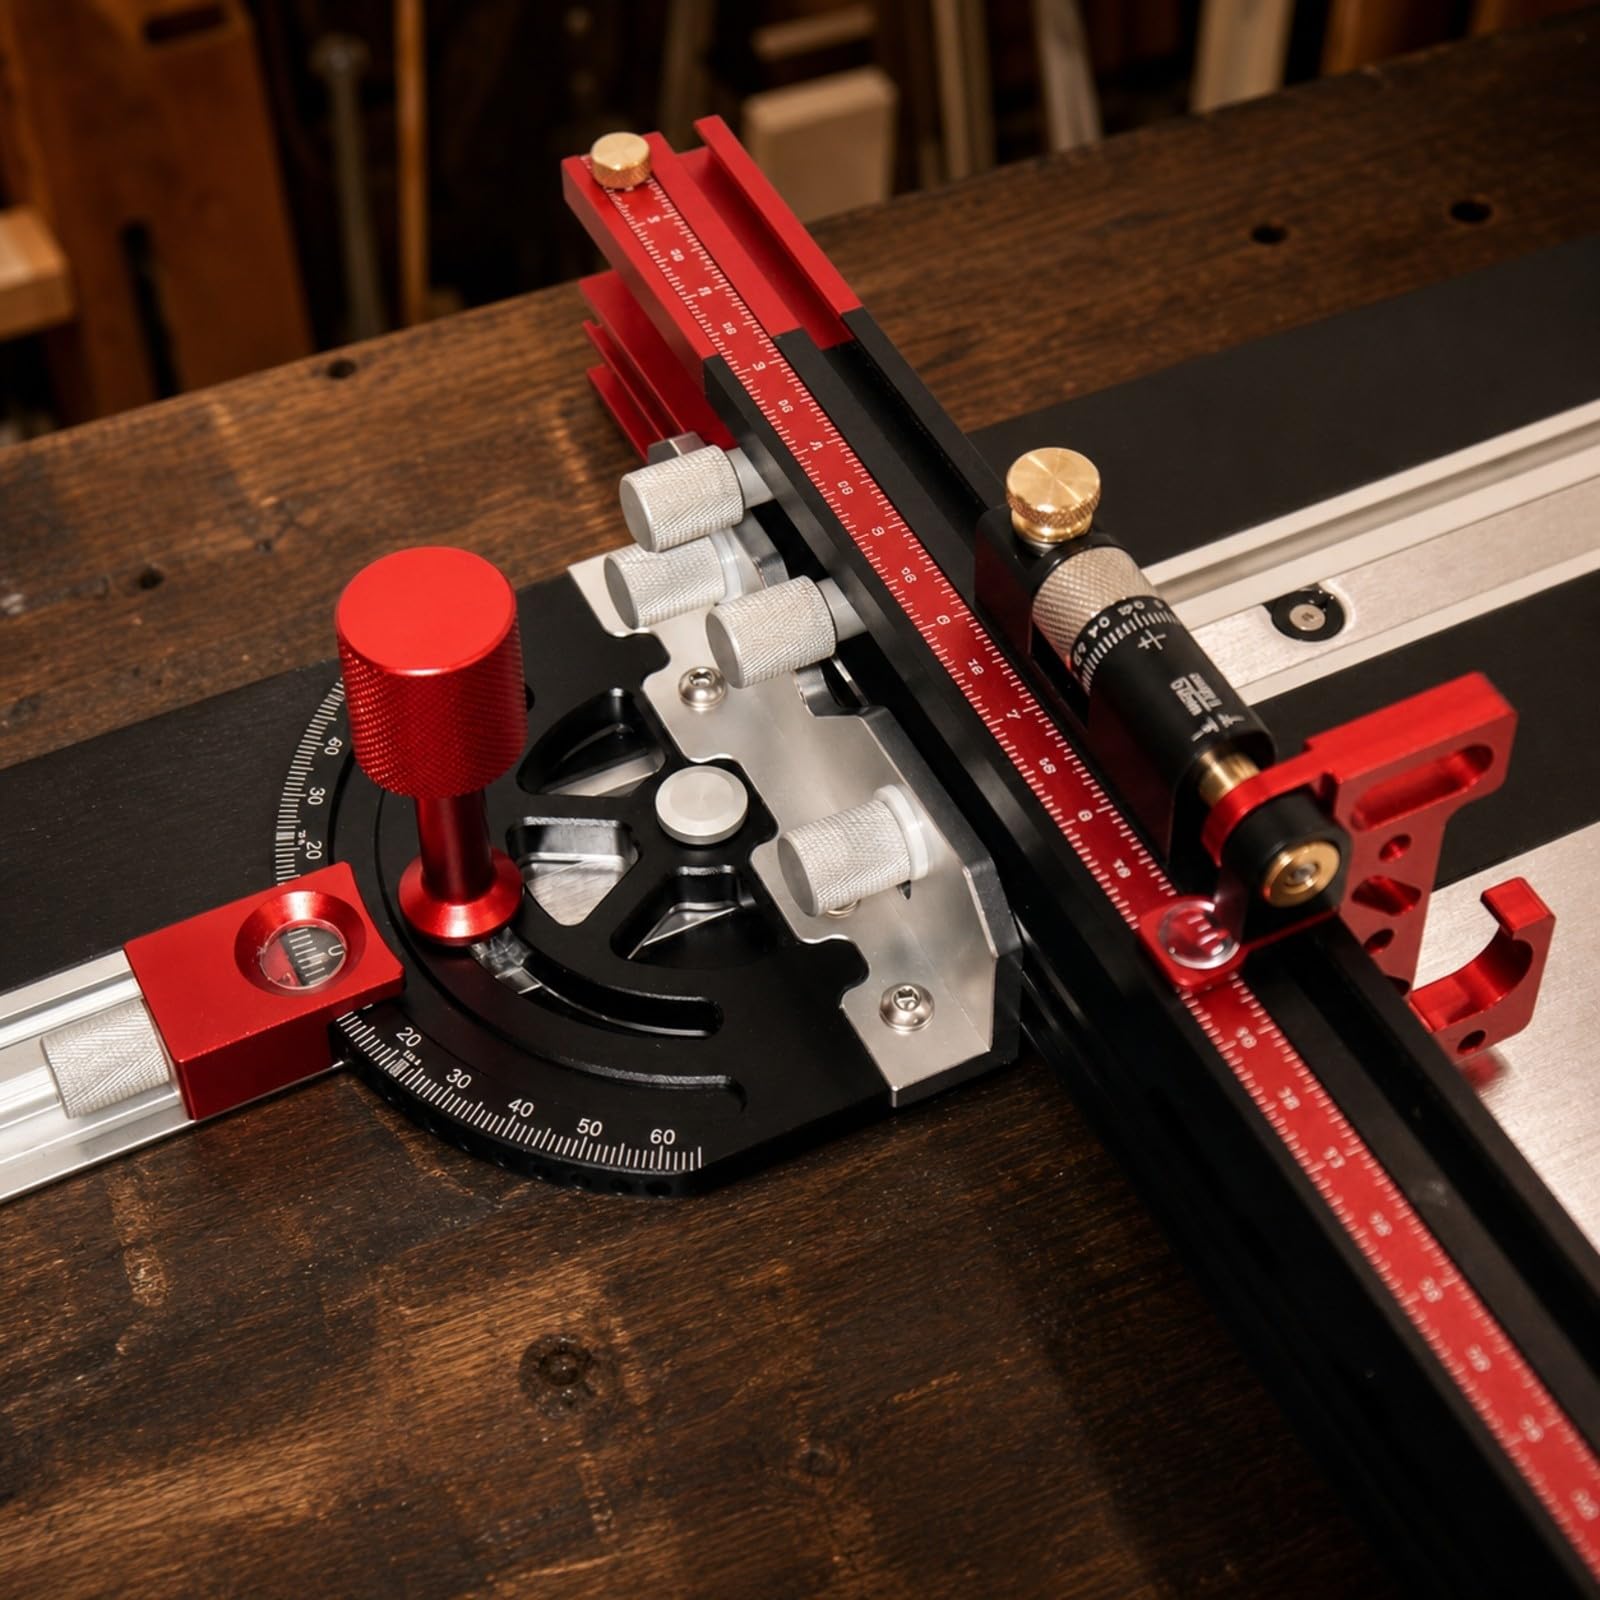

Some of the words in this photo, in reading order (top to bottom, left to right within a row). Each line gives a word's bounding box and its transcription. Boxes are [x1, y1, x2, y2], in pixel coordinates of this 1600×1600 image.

[307, 786, 326, 806] 30
[305, 840, 323, 860] 20
[396, 1026, 423, 1048] 20
[446, 1068, 472, 1089] 30
[507, 1098, 534, 1118] 40
[576, 1118, 603, 1137] 50
[650, 1128, 676, 1145] 60
